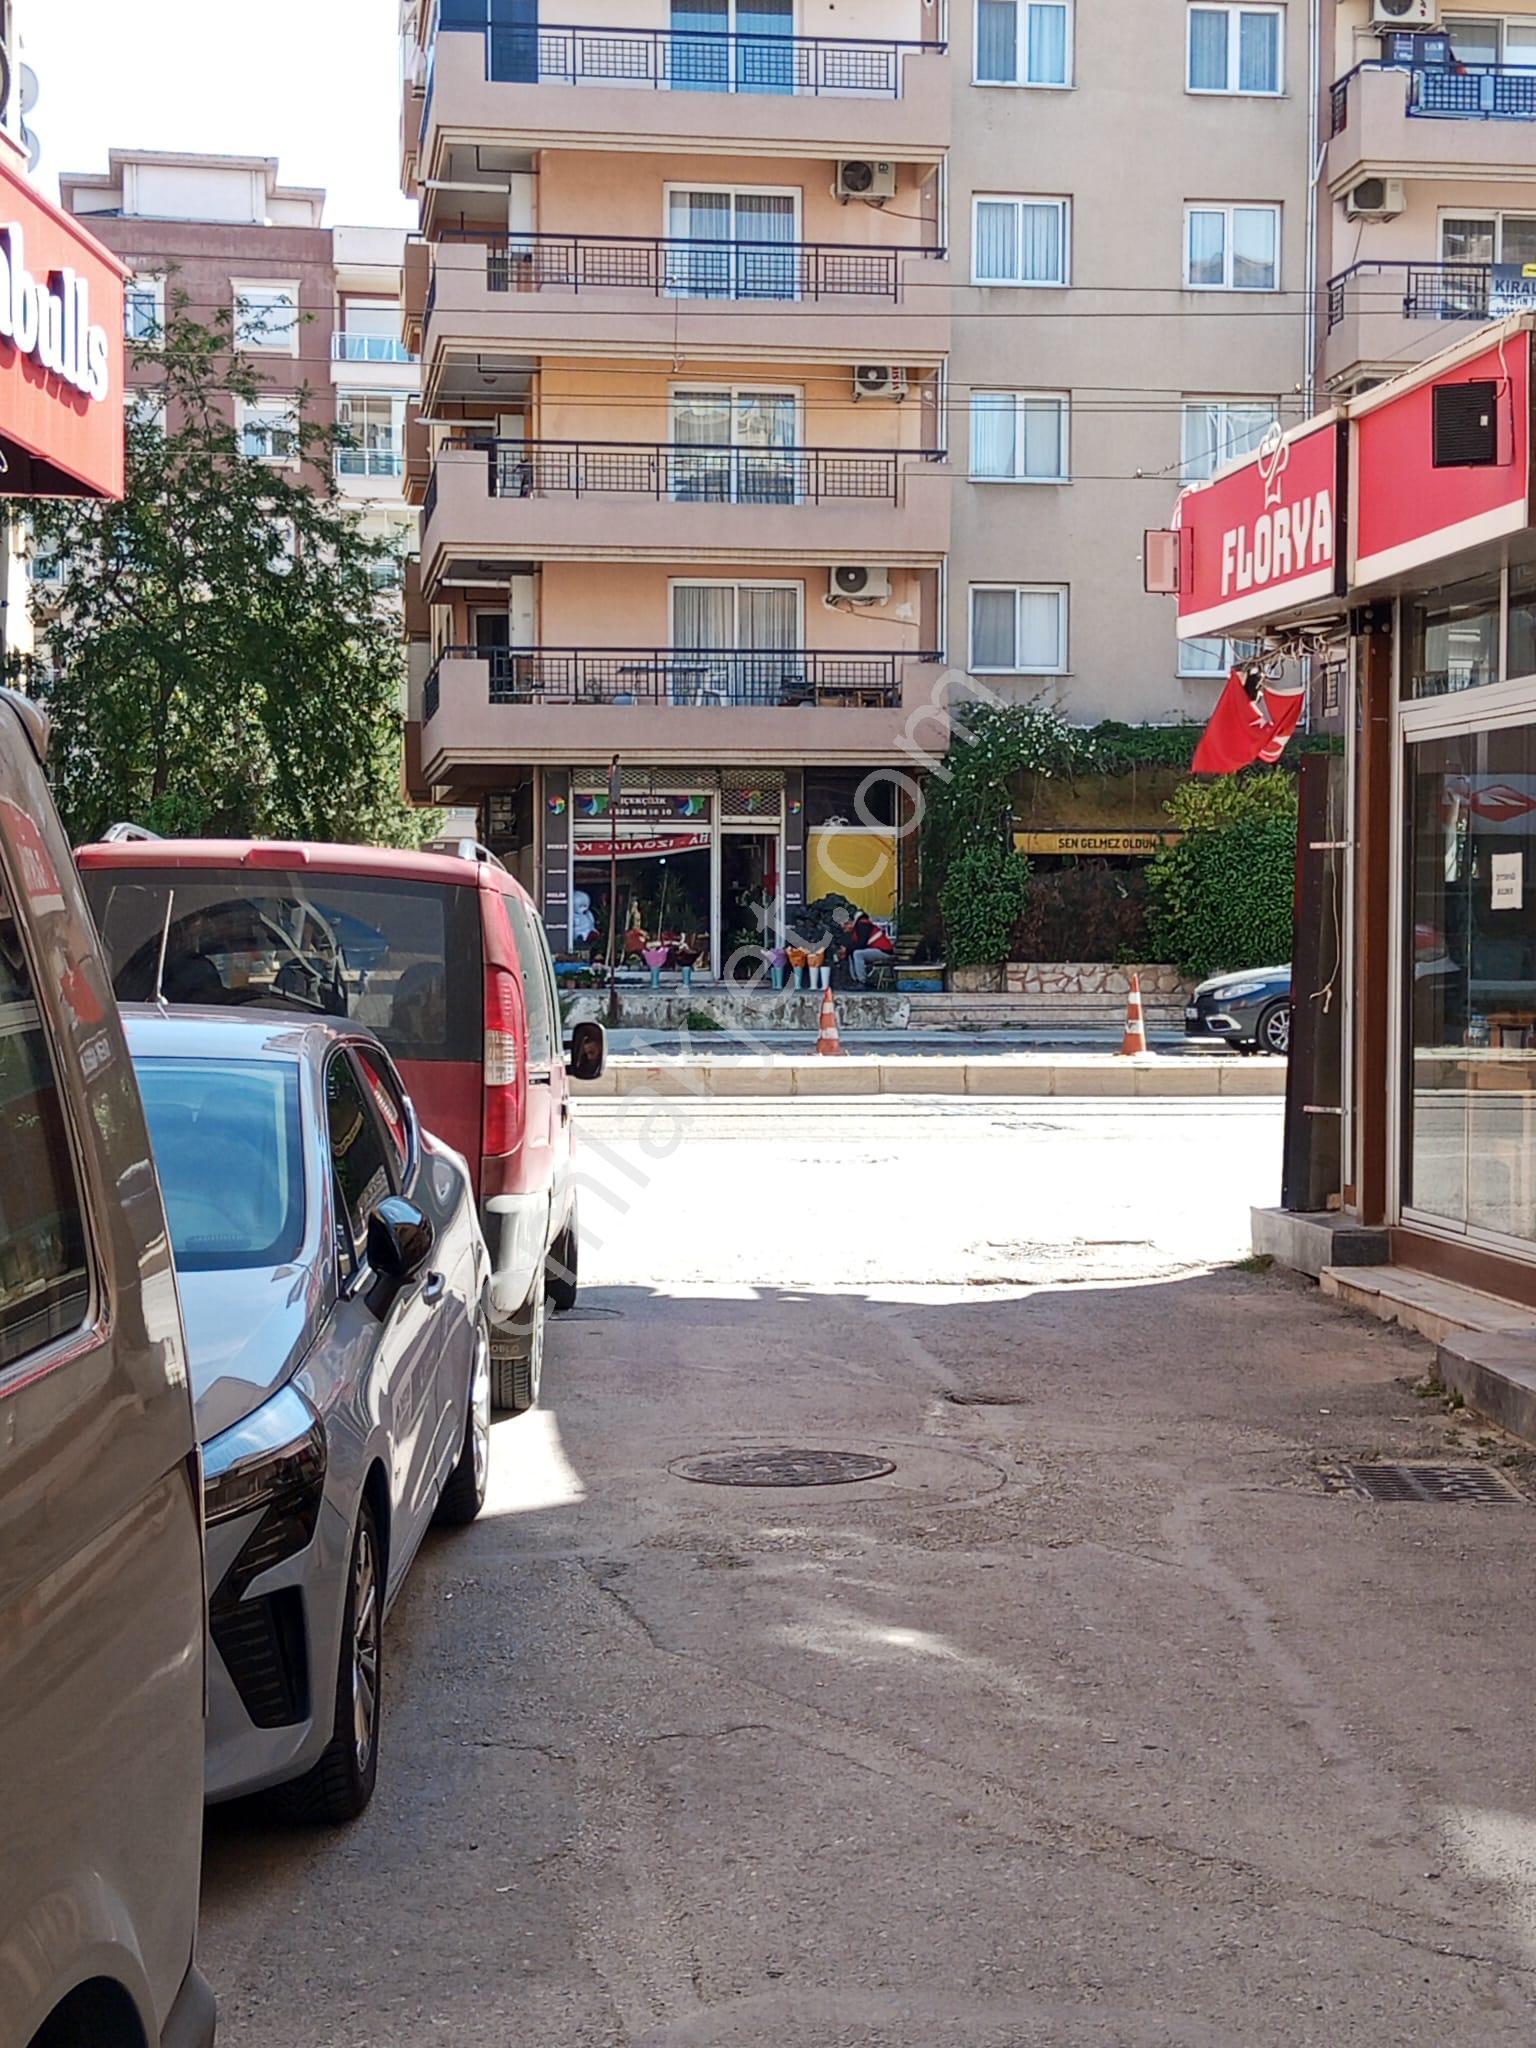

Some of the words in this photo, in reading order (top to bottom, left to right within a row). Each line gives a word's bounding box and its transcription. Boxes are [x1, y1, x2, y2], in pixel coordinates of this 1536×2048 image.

[0, 221, 109, 403] bulls
[1221, 489, 1333, 597] FLORYA
[1058, 838, 1078, 849] SEN
[1081, 838, 1120, 849] GELMEZ
